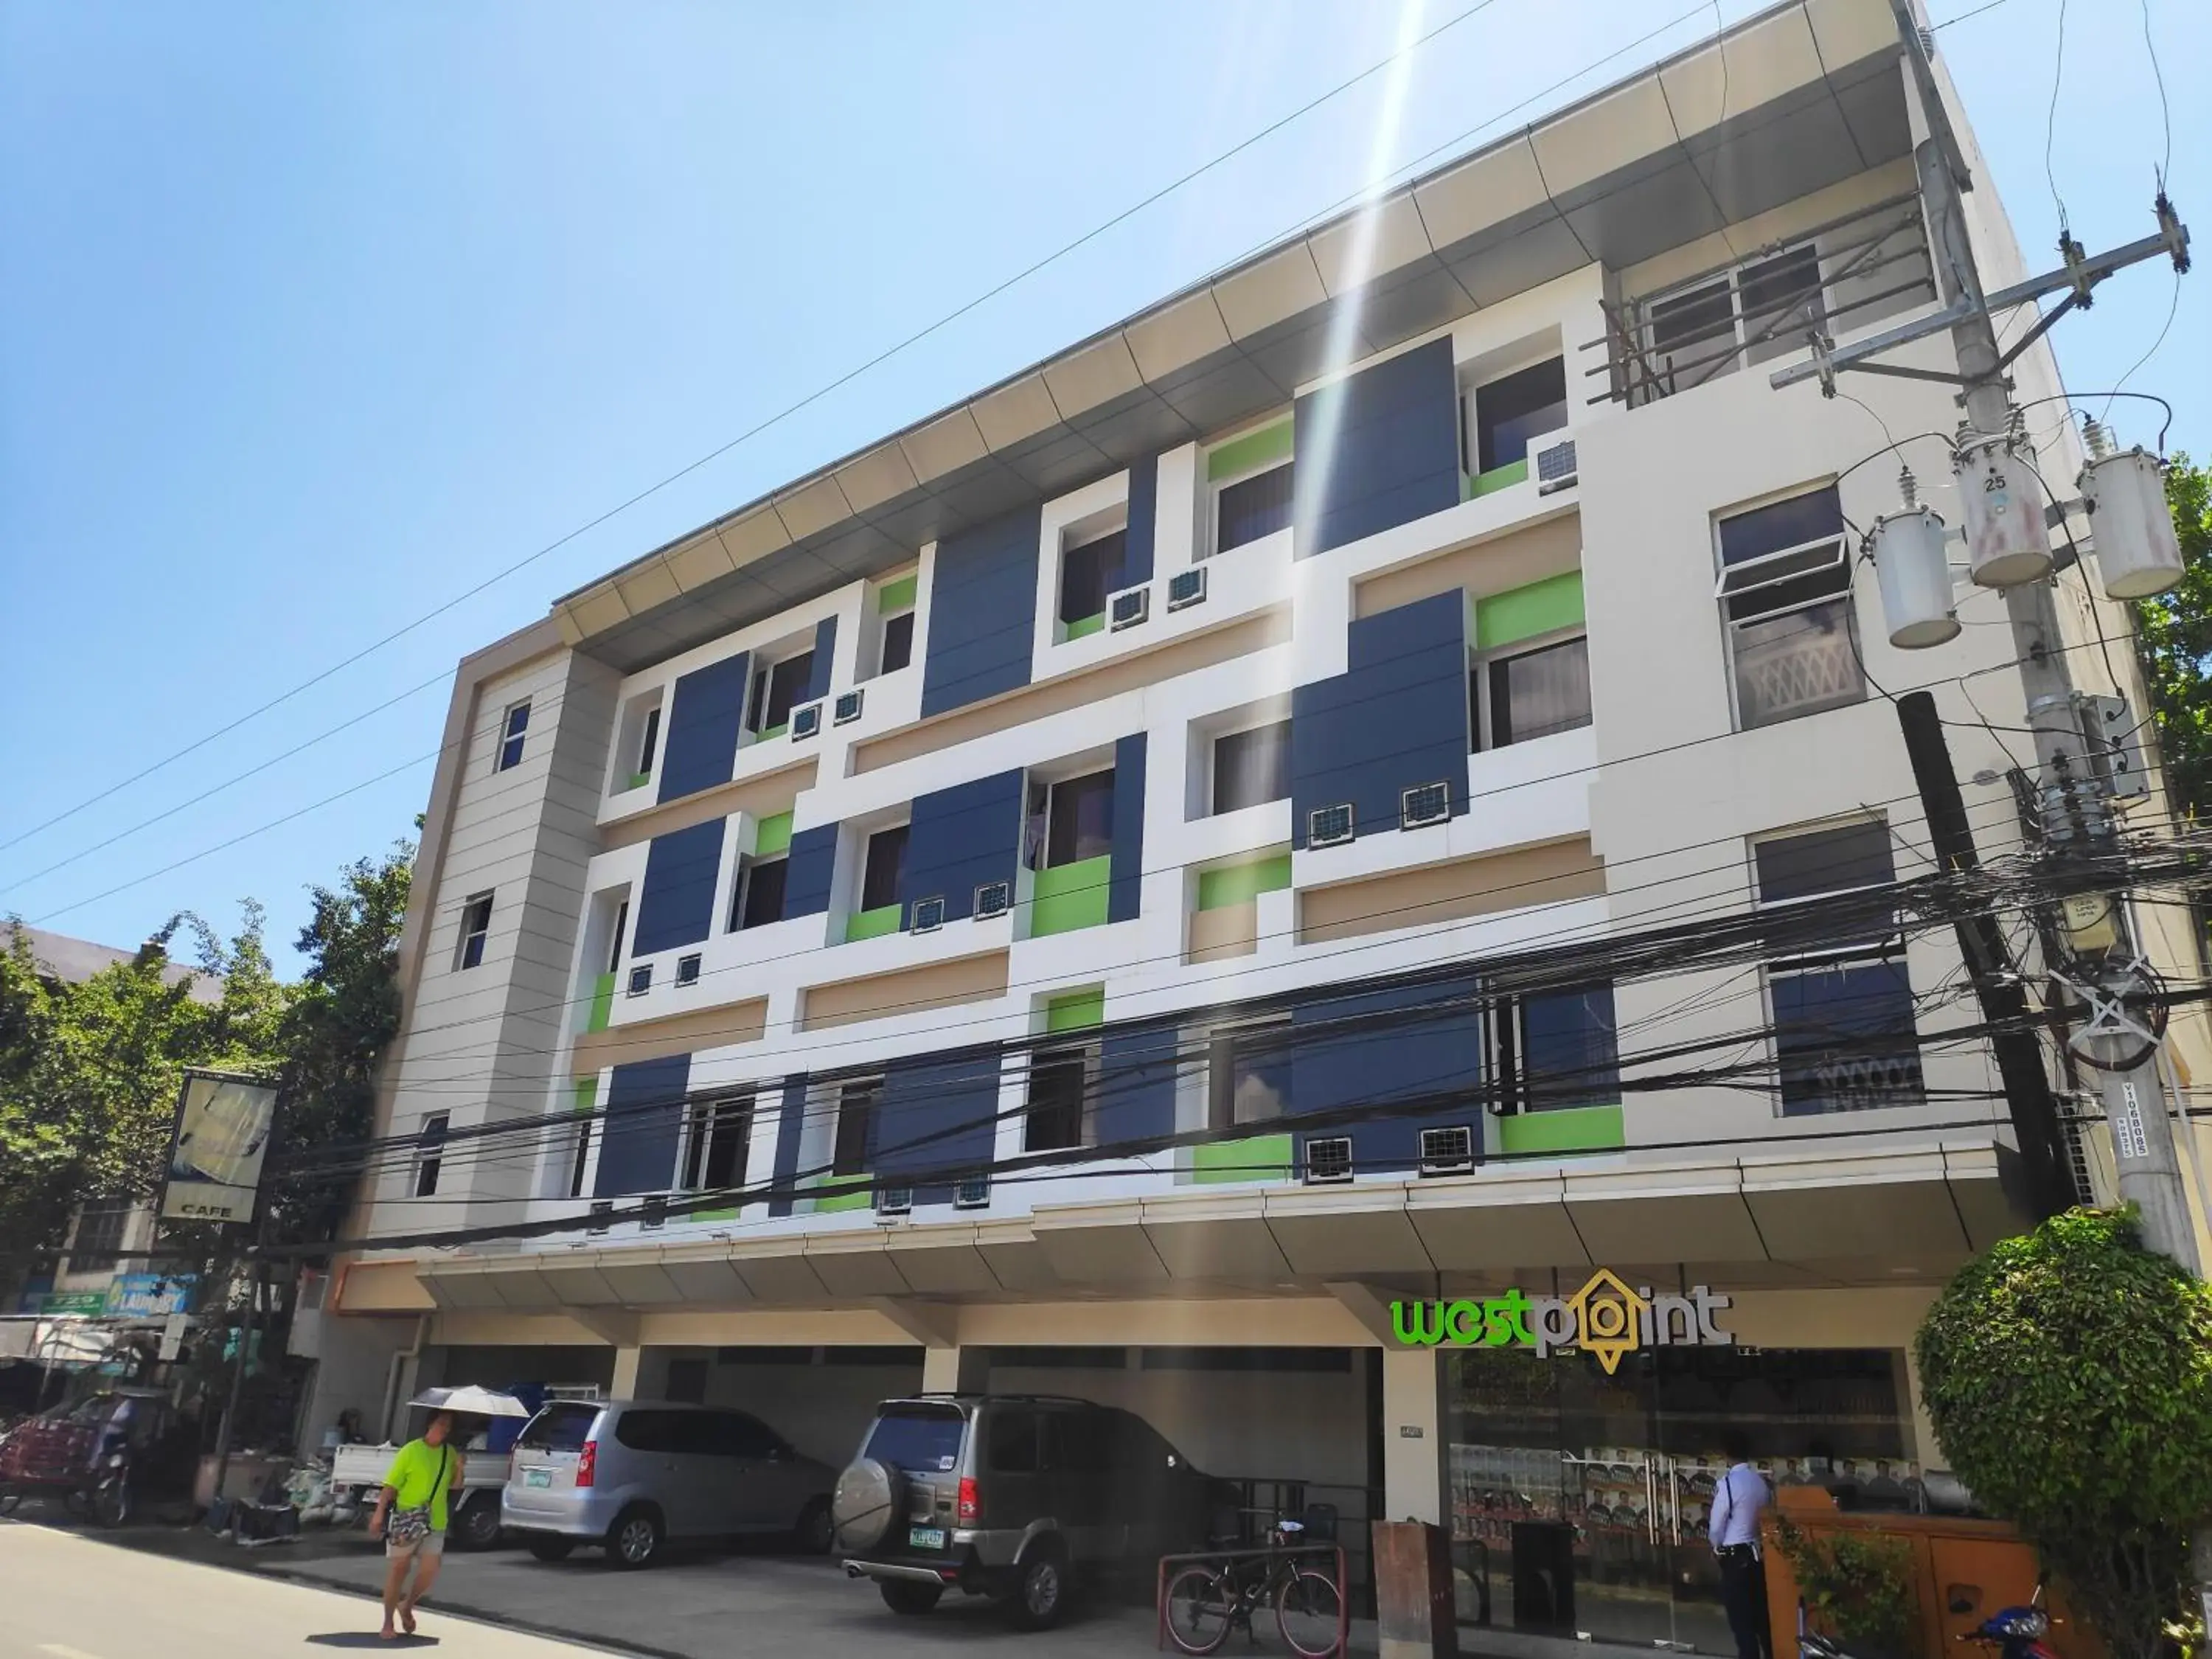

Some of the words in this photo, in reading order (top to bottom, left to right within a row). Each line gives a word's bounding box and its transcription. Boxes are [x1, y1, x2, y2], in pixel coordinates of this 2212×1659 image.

[1985, 475, 2006, 492] 25
[181, 1204, 232, 1217] CAFE
[1391, 1286, 1732, 1358] westpoint
